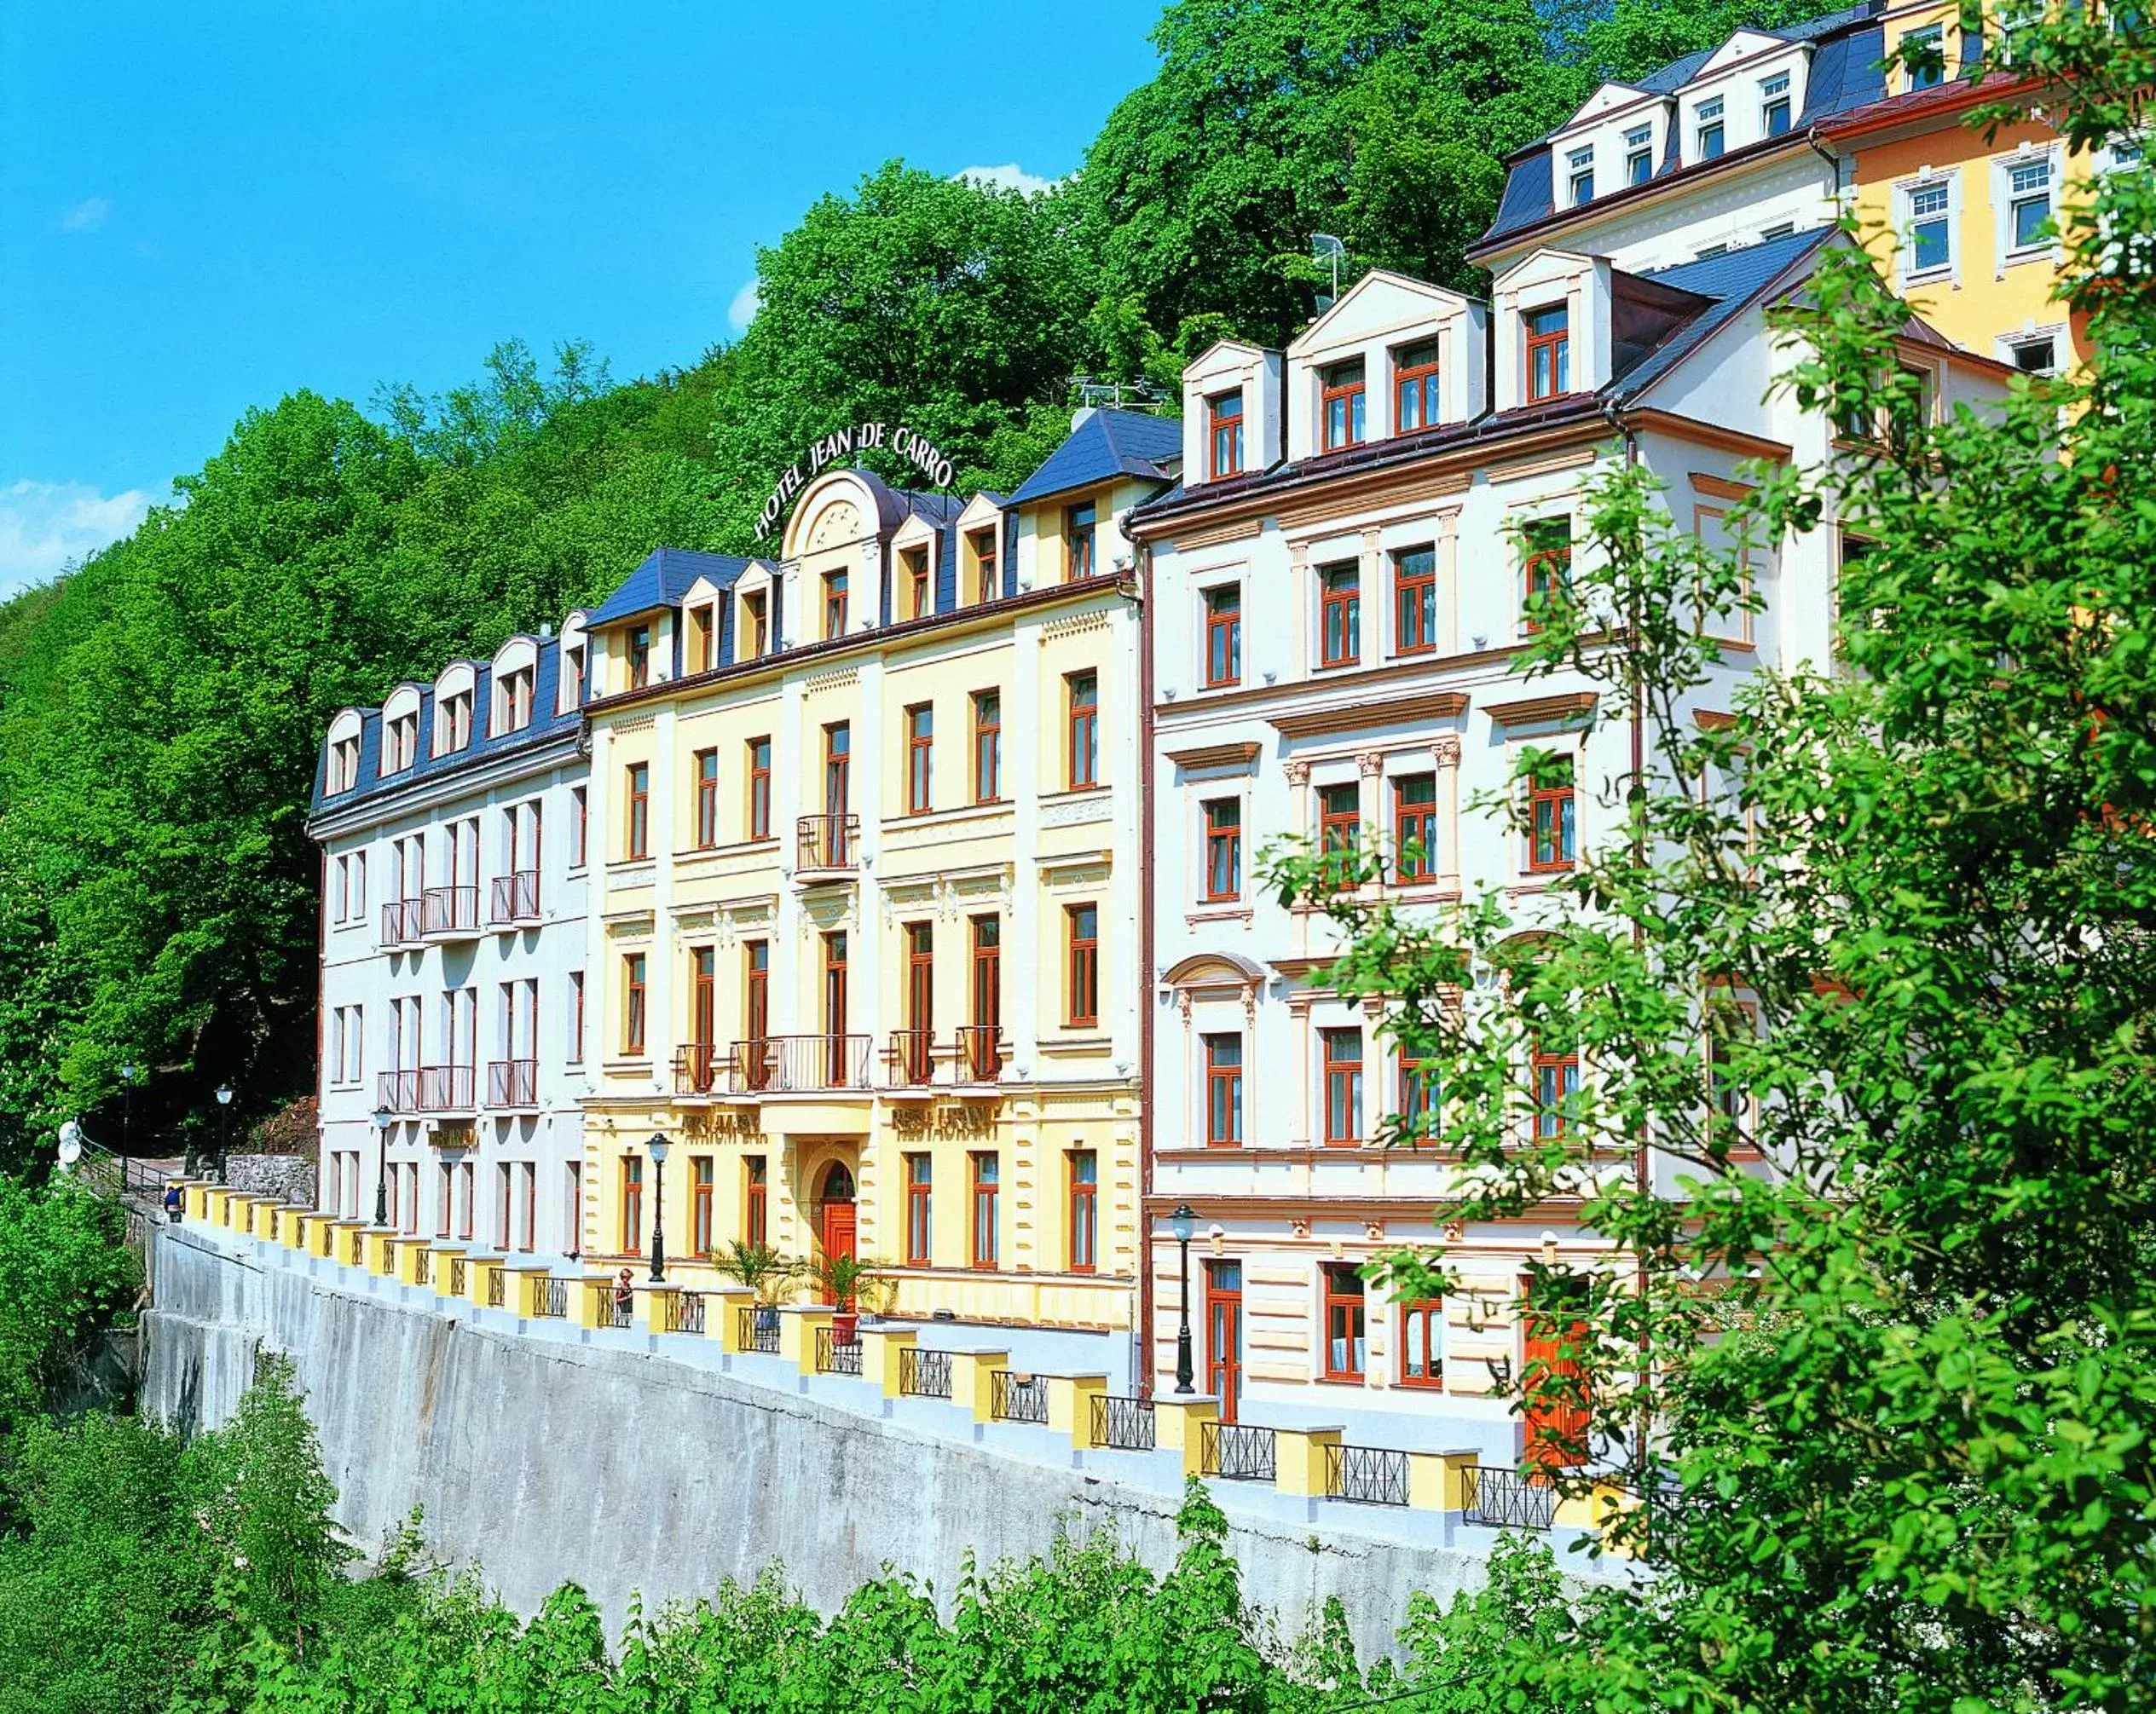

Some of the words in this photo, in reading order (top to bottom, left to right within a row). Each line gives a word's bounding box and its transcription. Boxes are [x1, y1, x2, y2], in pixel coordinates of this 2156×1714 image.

[754, 465, 805, 540] HOTEL
[809, 426, 852, 475] JEAN
[860, 423, 887, 448] DE
[894, 427, 953, 488] CARRO
